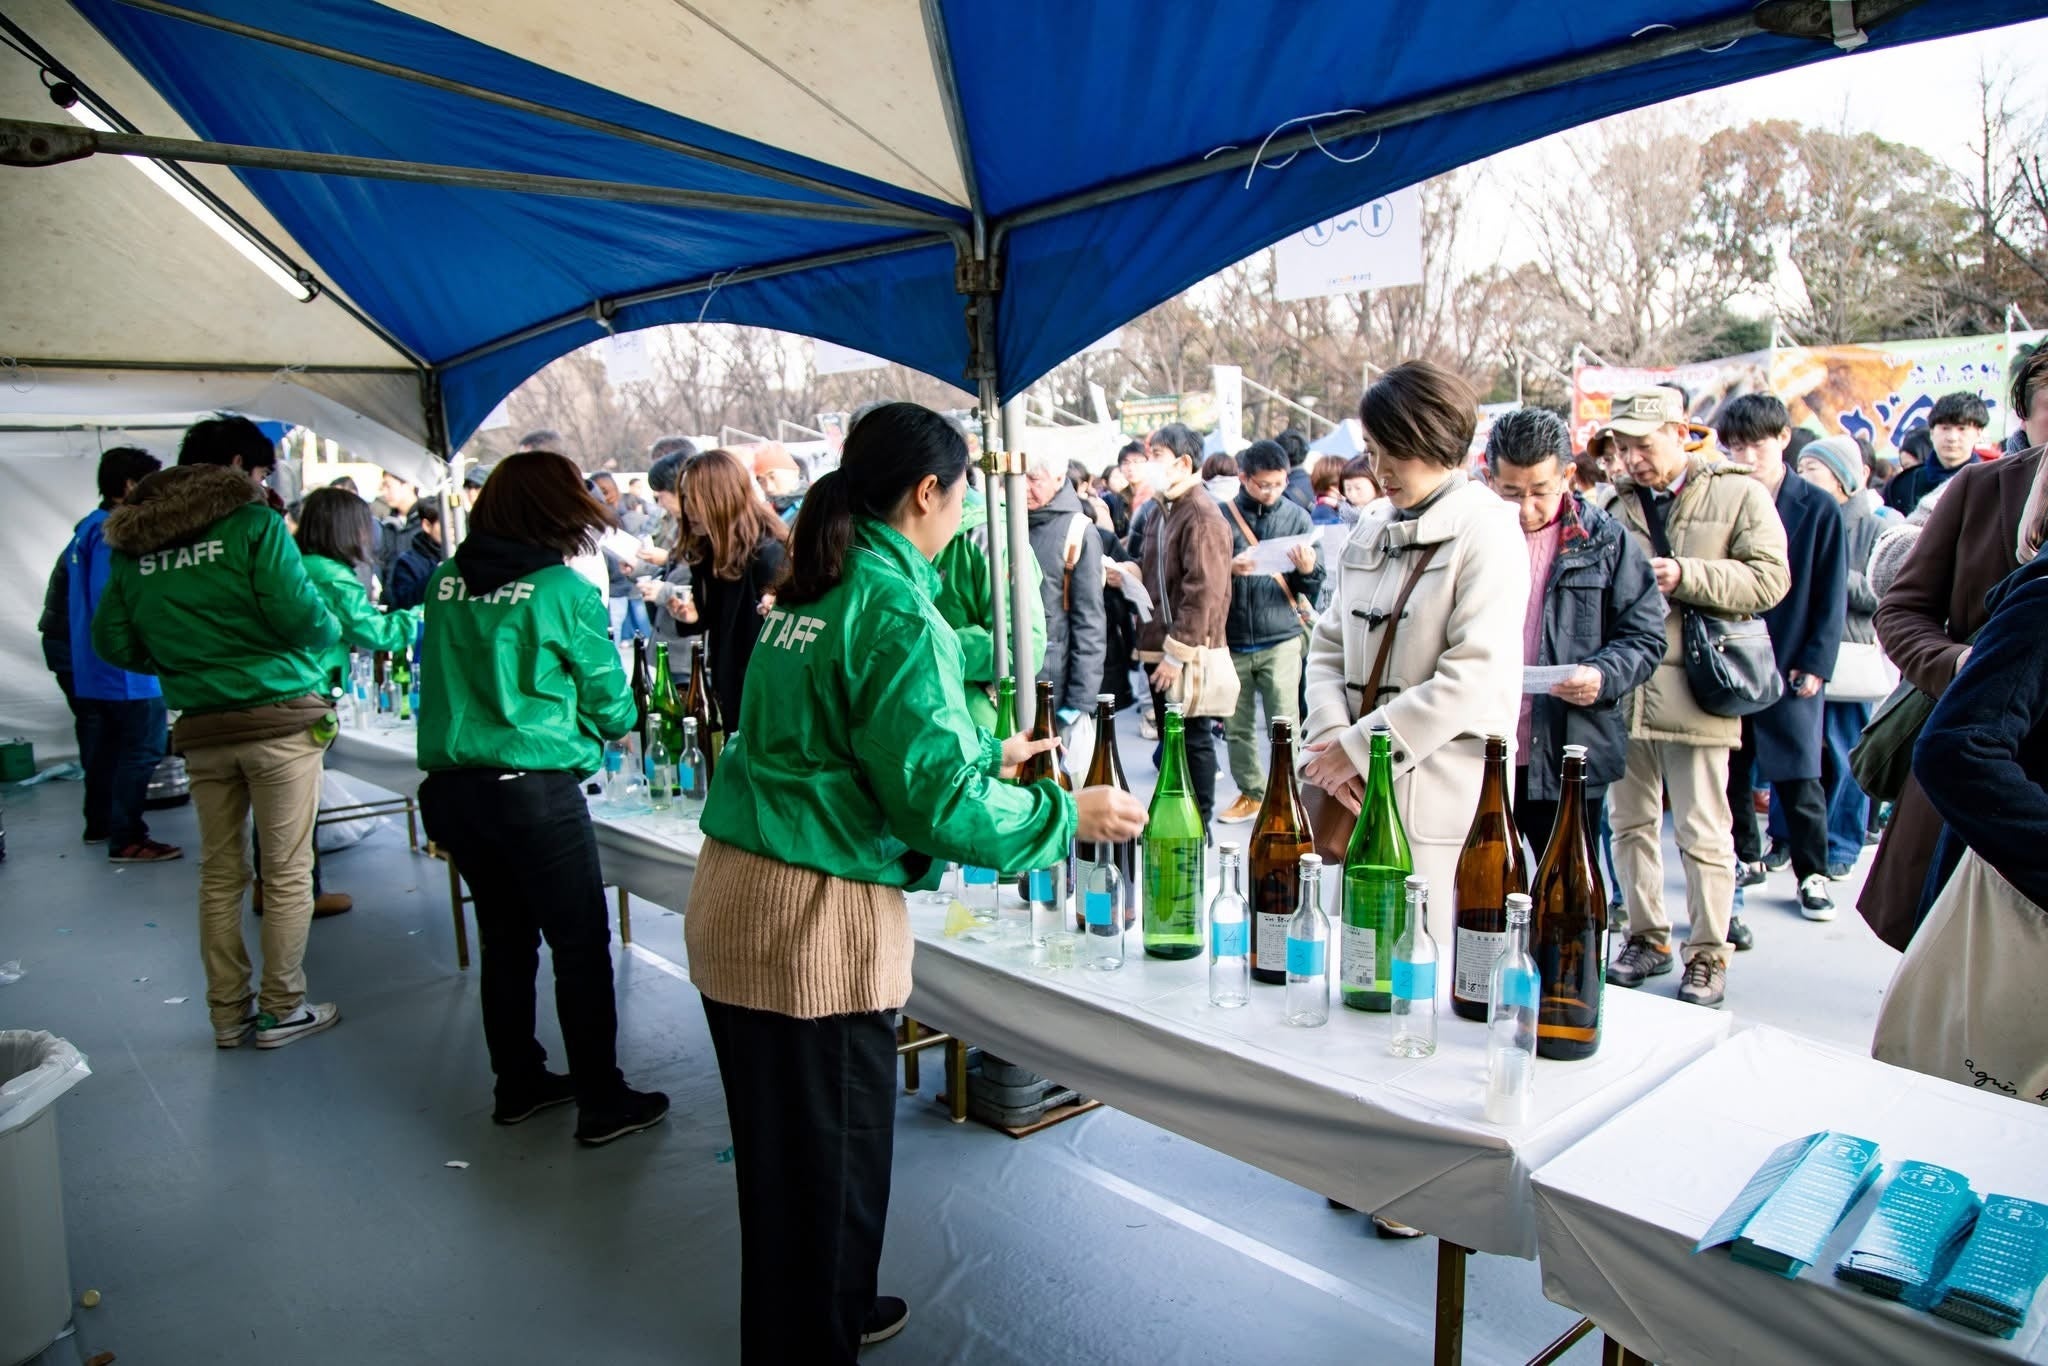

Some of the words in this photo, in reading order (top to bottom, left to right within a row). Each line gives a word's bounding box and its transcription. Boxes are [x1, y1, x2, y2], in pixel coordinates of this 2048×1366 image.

[140, 540, 224, 575] STAFF
[438, 576, 535, 605] STFF
[760, 610, 827, 653] TAFF
[1224, 926, 1241, 951] 4
[1965, 1059, 2017, 1095] agnès
